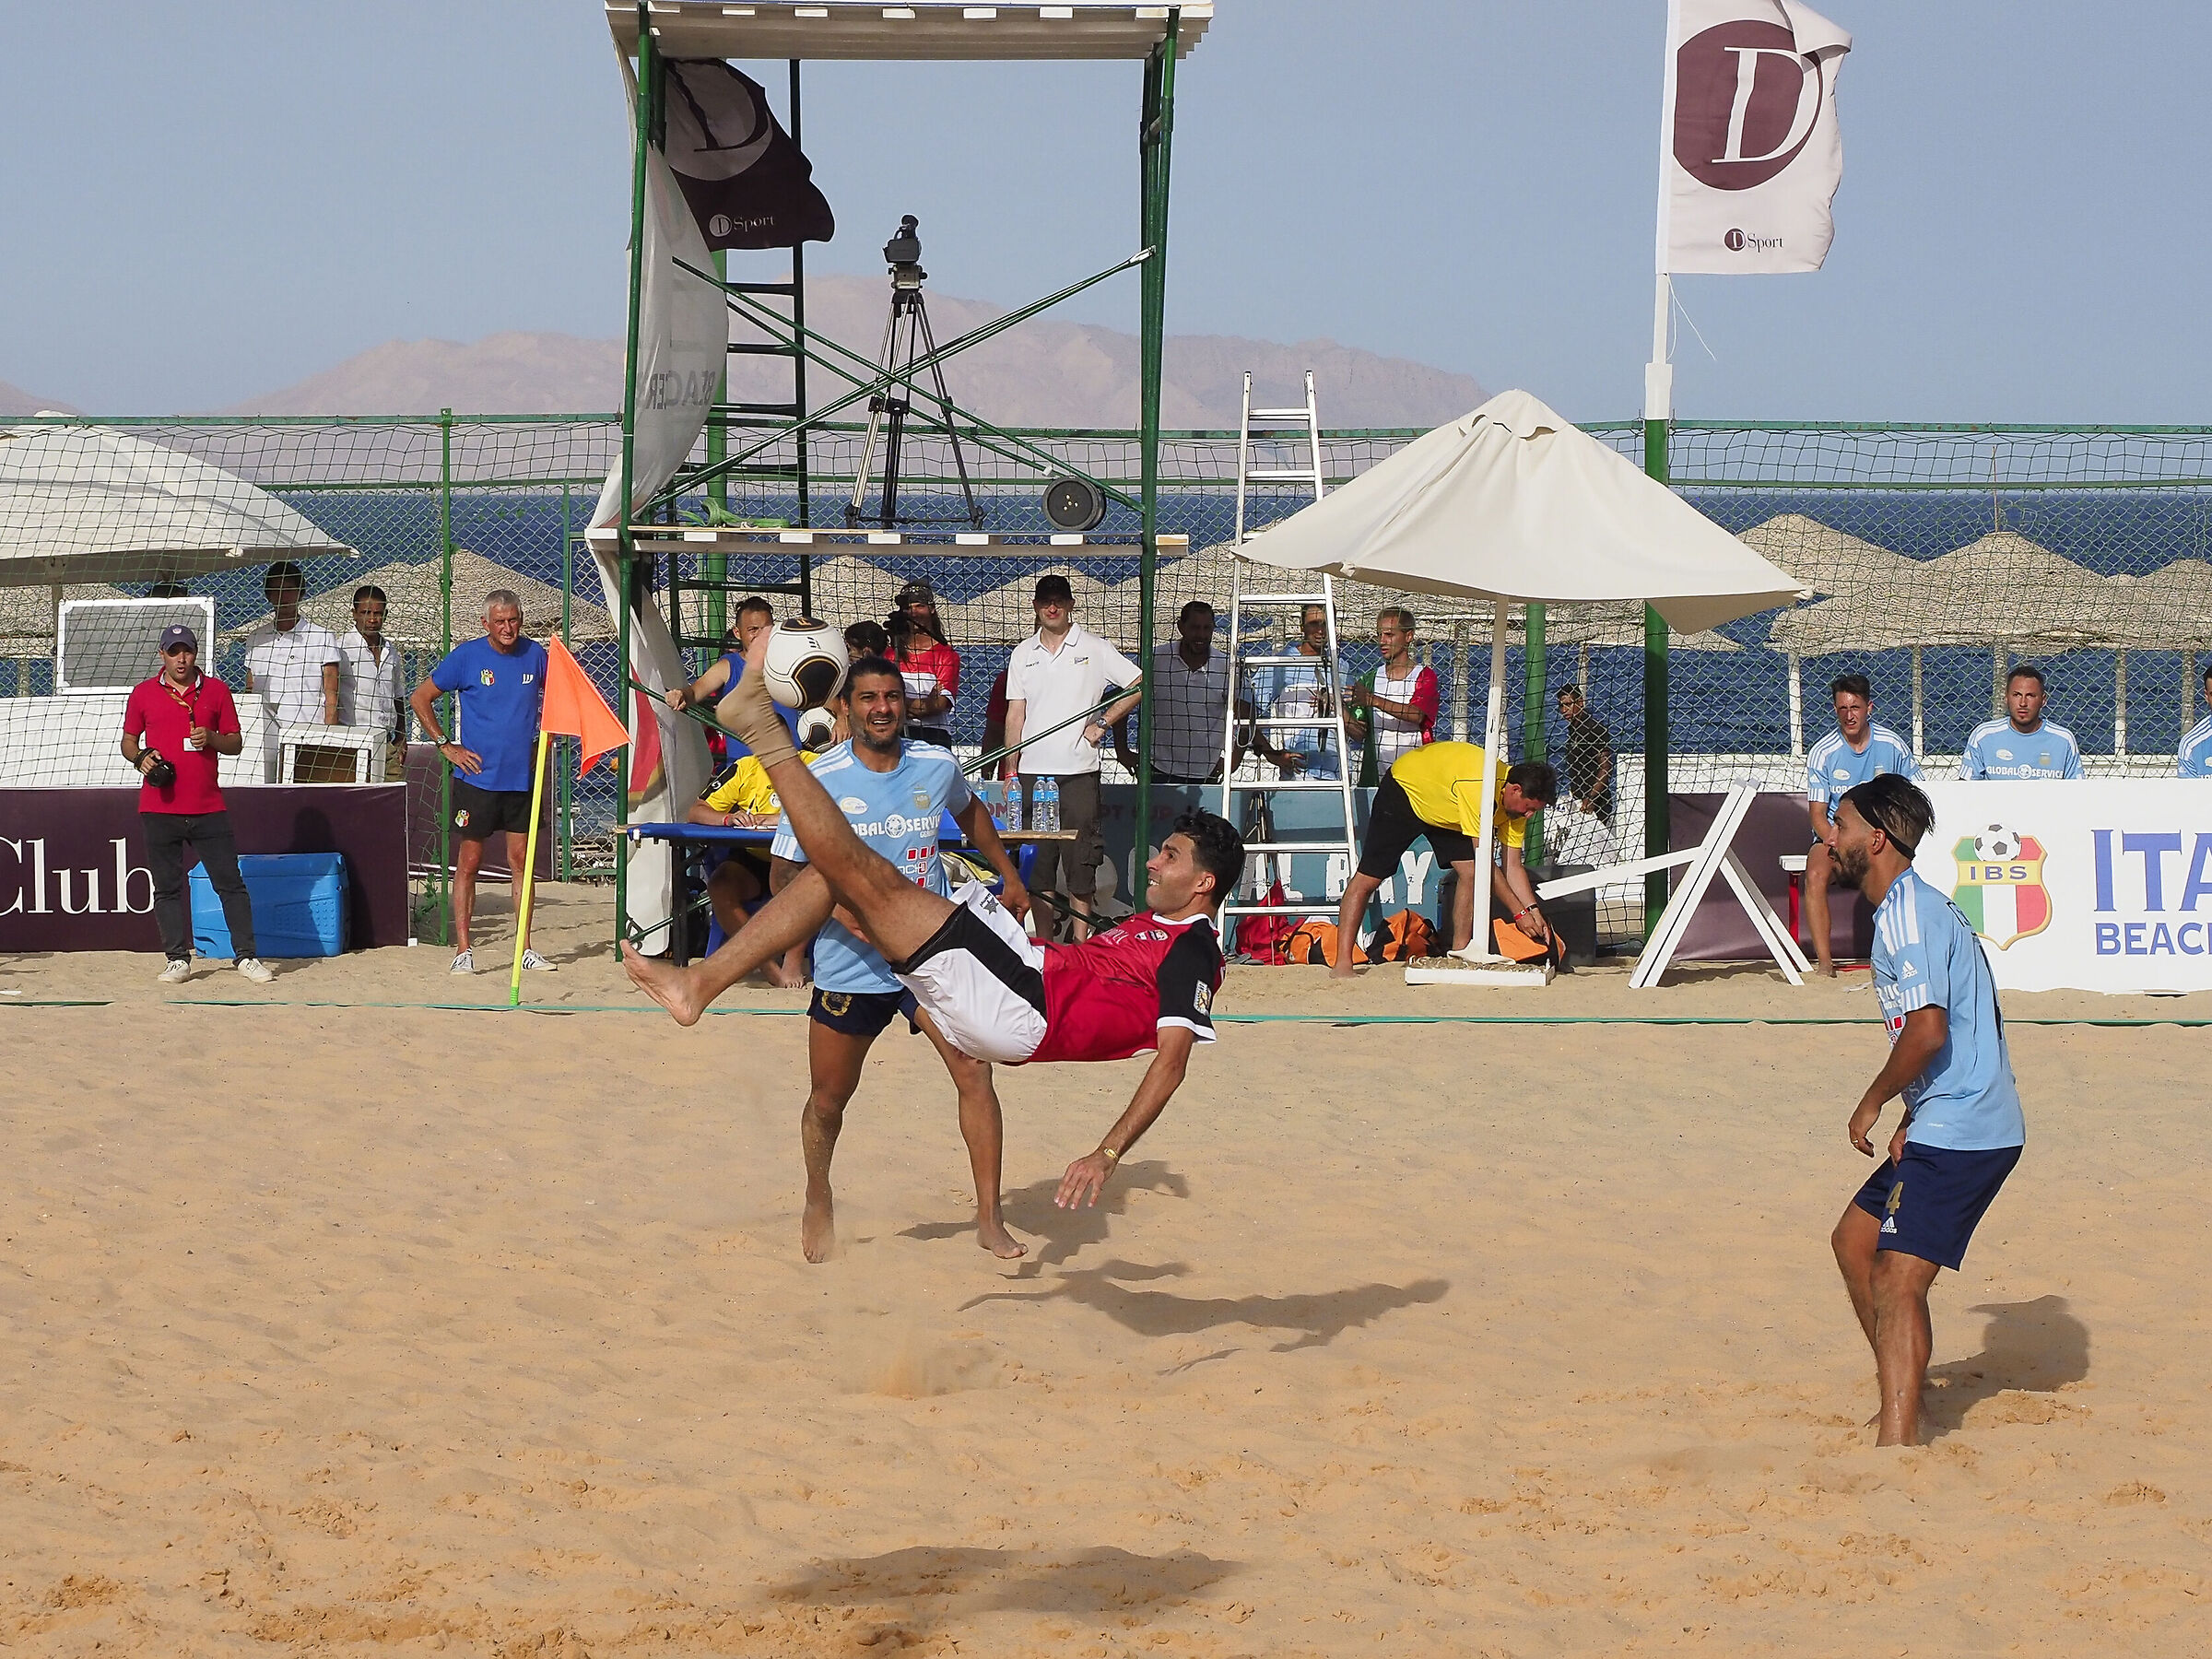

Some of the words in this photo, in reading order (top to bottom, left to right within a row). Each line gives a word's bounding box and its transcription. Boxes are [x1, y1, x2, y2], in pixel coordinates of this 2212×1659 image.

[1712, 46, 1820, 163] D
[734, 215, 774, 232] Sport
[1747, 234, 1783, 253] Sport
[1986, 766, 2018, 776] GLOBAL
[906, 814, 940, 831] SERVI
[1970, 865, 2028, 880] IBS
[2095, 923, 2212, 956] BEAC
[1886, 1181, 1903, 1215] 4
